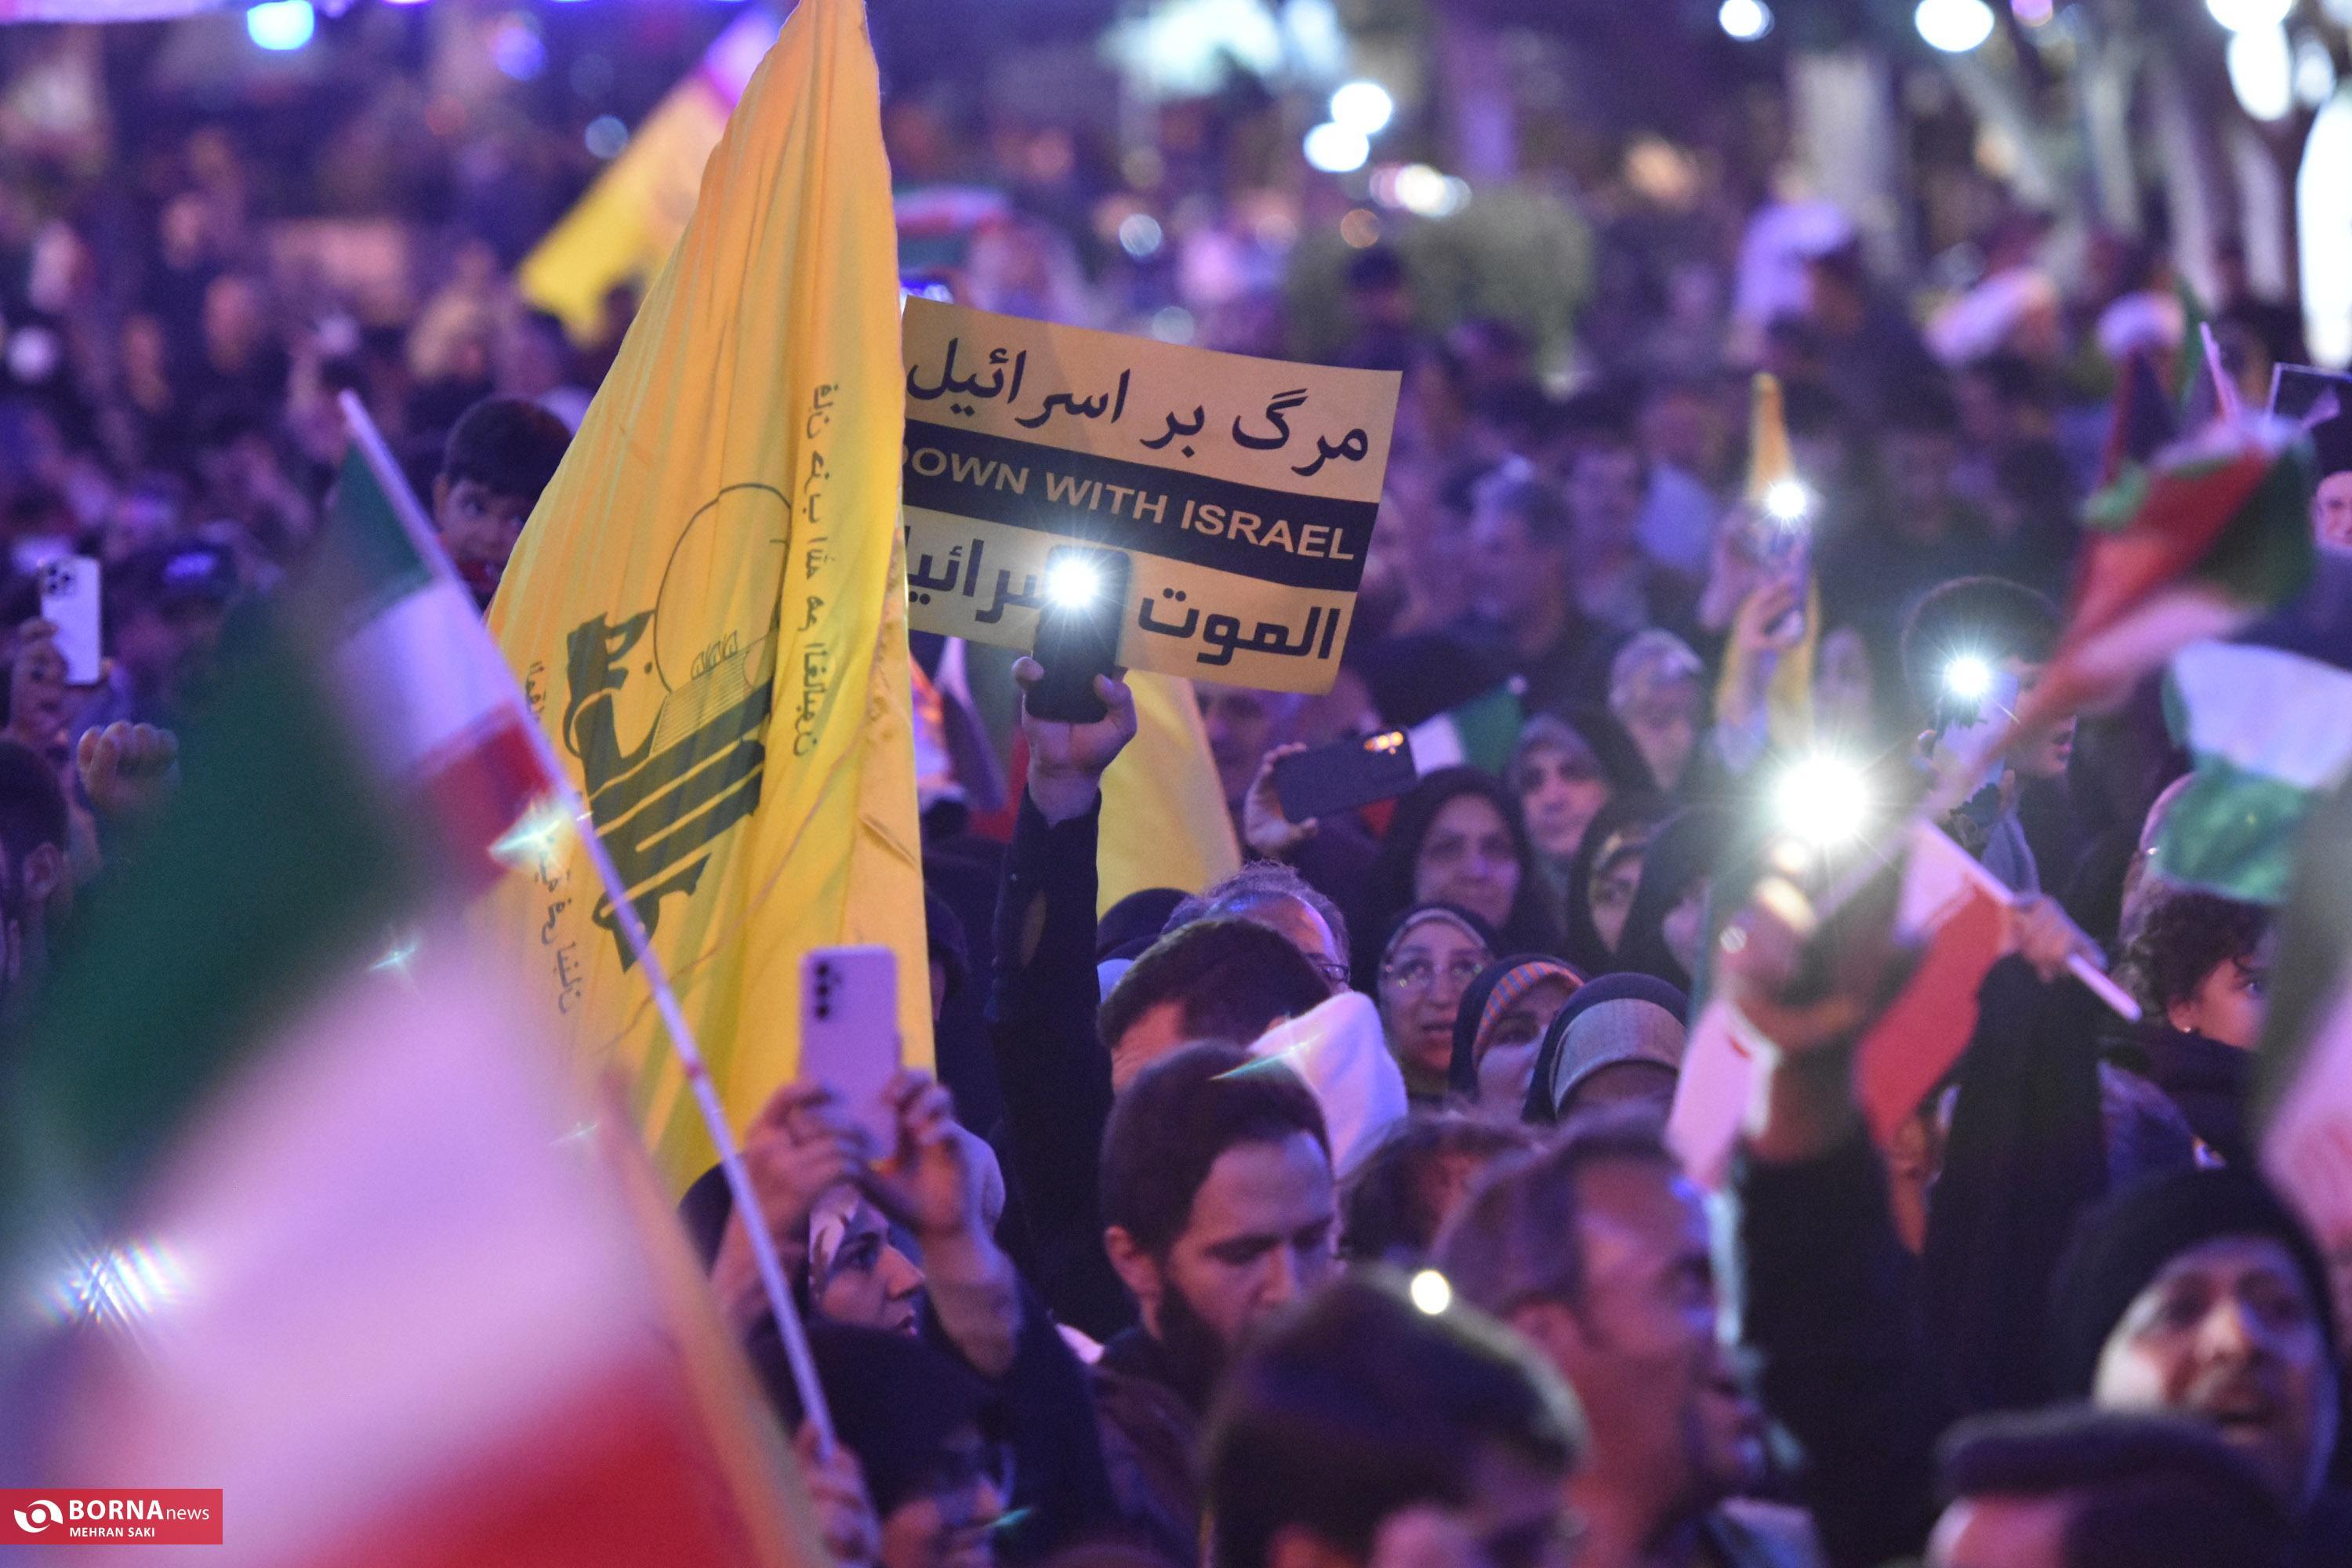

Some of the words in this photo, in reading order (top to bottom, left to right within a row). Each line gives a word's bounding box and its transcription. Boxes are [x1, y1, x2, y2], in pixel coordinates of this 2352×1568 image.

[1140, 405, 1205, 458] بر
[1232, 388, 1369, 477] مرگ
[902, 442, 1030, 495] OWN
[1046, 473, 1167, 524] WITH
[1181, 500, 1354, 560] ISRAEL
[1138, 588, 1341, 666] الموت
